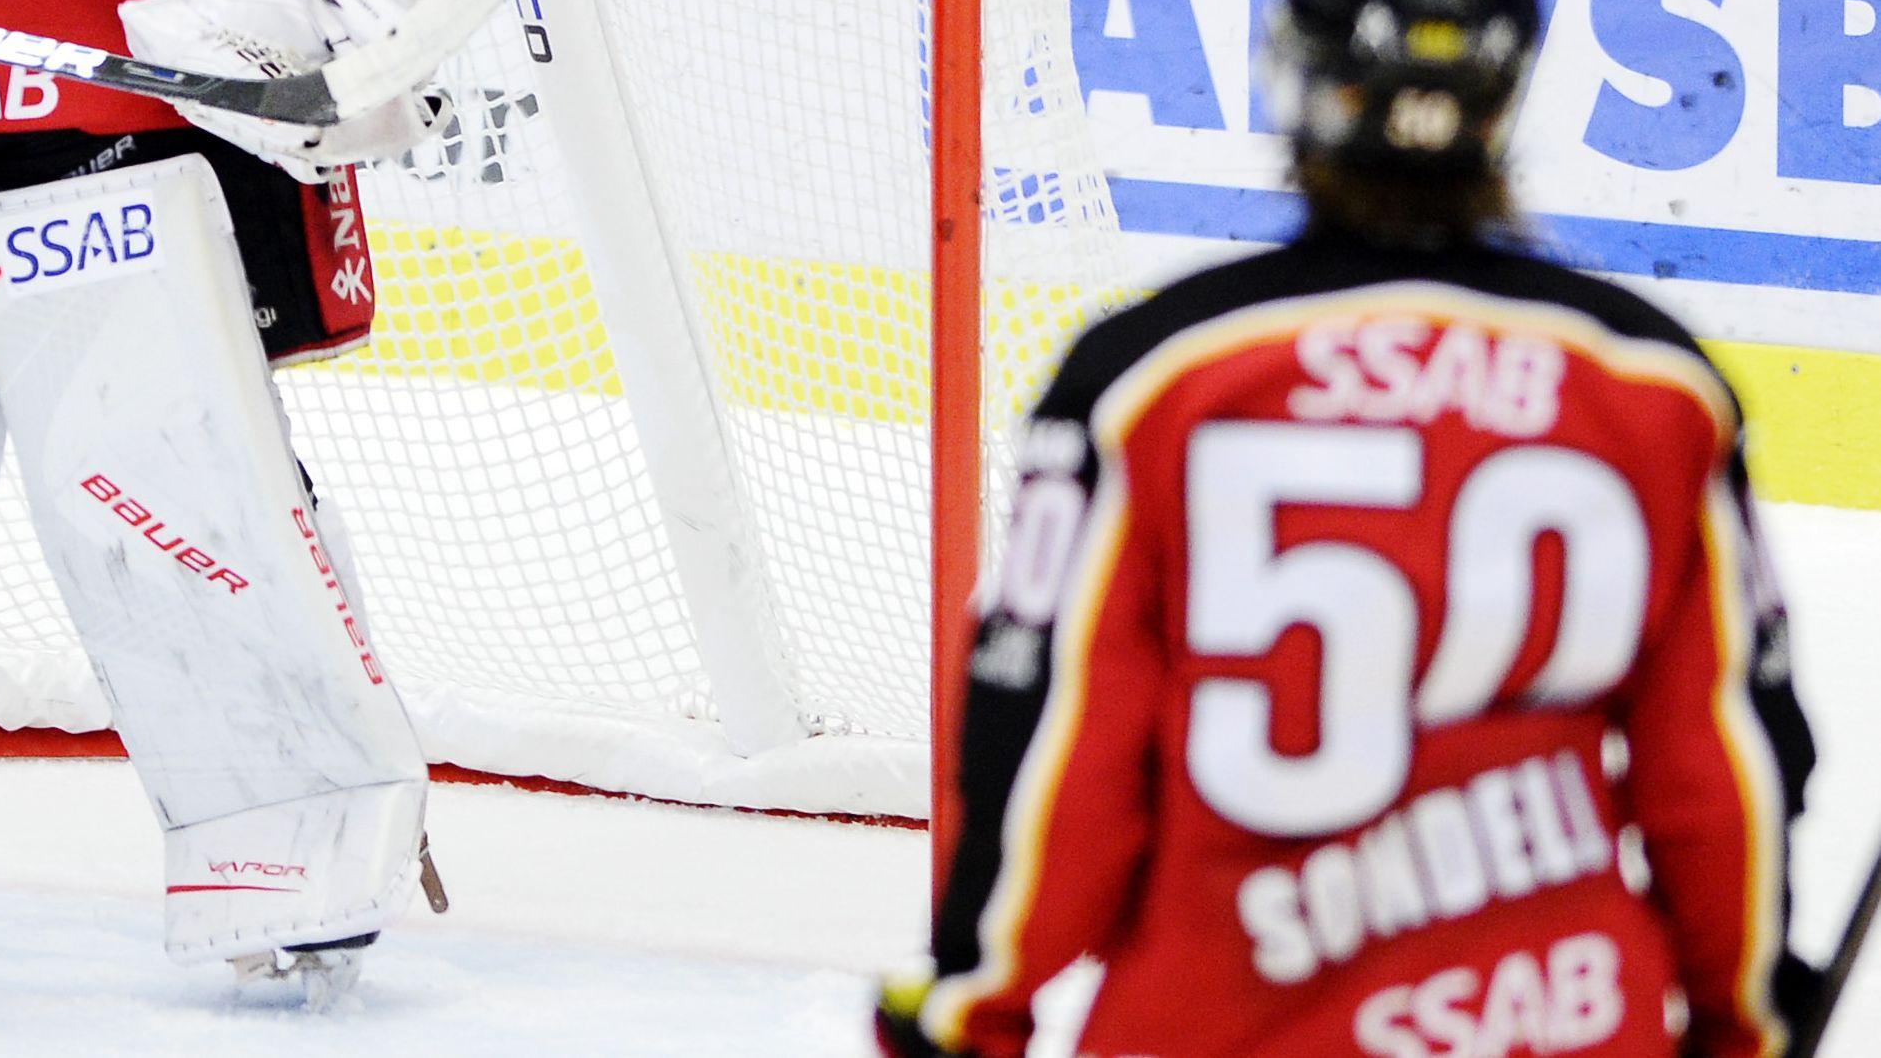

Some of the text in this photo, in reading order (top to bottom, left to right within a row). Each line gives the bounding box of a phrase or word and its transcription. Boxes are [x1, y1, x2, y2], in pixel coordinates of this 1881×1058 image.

[6, 203, 155, 284] SSAB
[1288, 318, 1569, 437] SSAB
[80, 473, 249, 595] BAUER
[1186, 419, 1652, 839] 50
[207, 860, 310, 888] VAPOR
[1235, 748, 1612, 987] SONDELL
[1352, 932, 1627, 1058] SSAB
